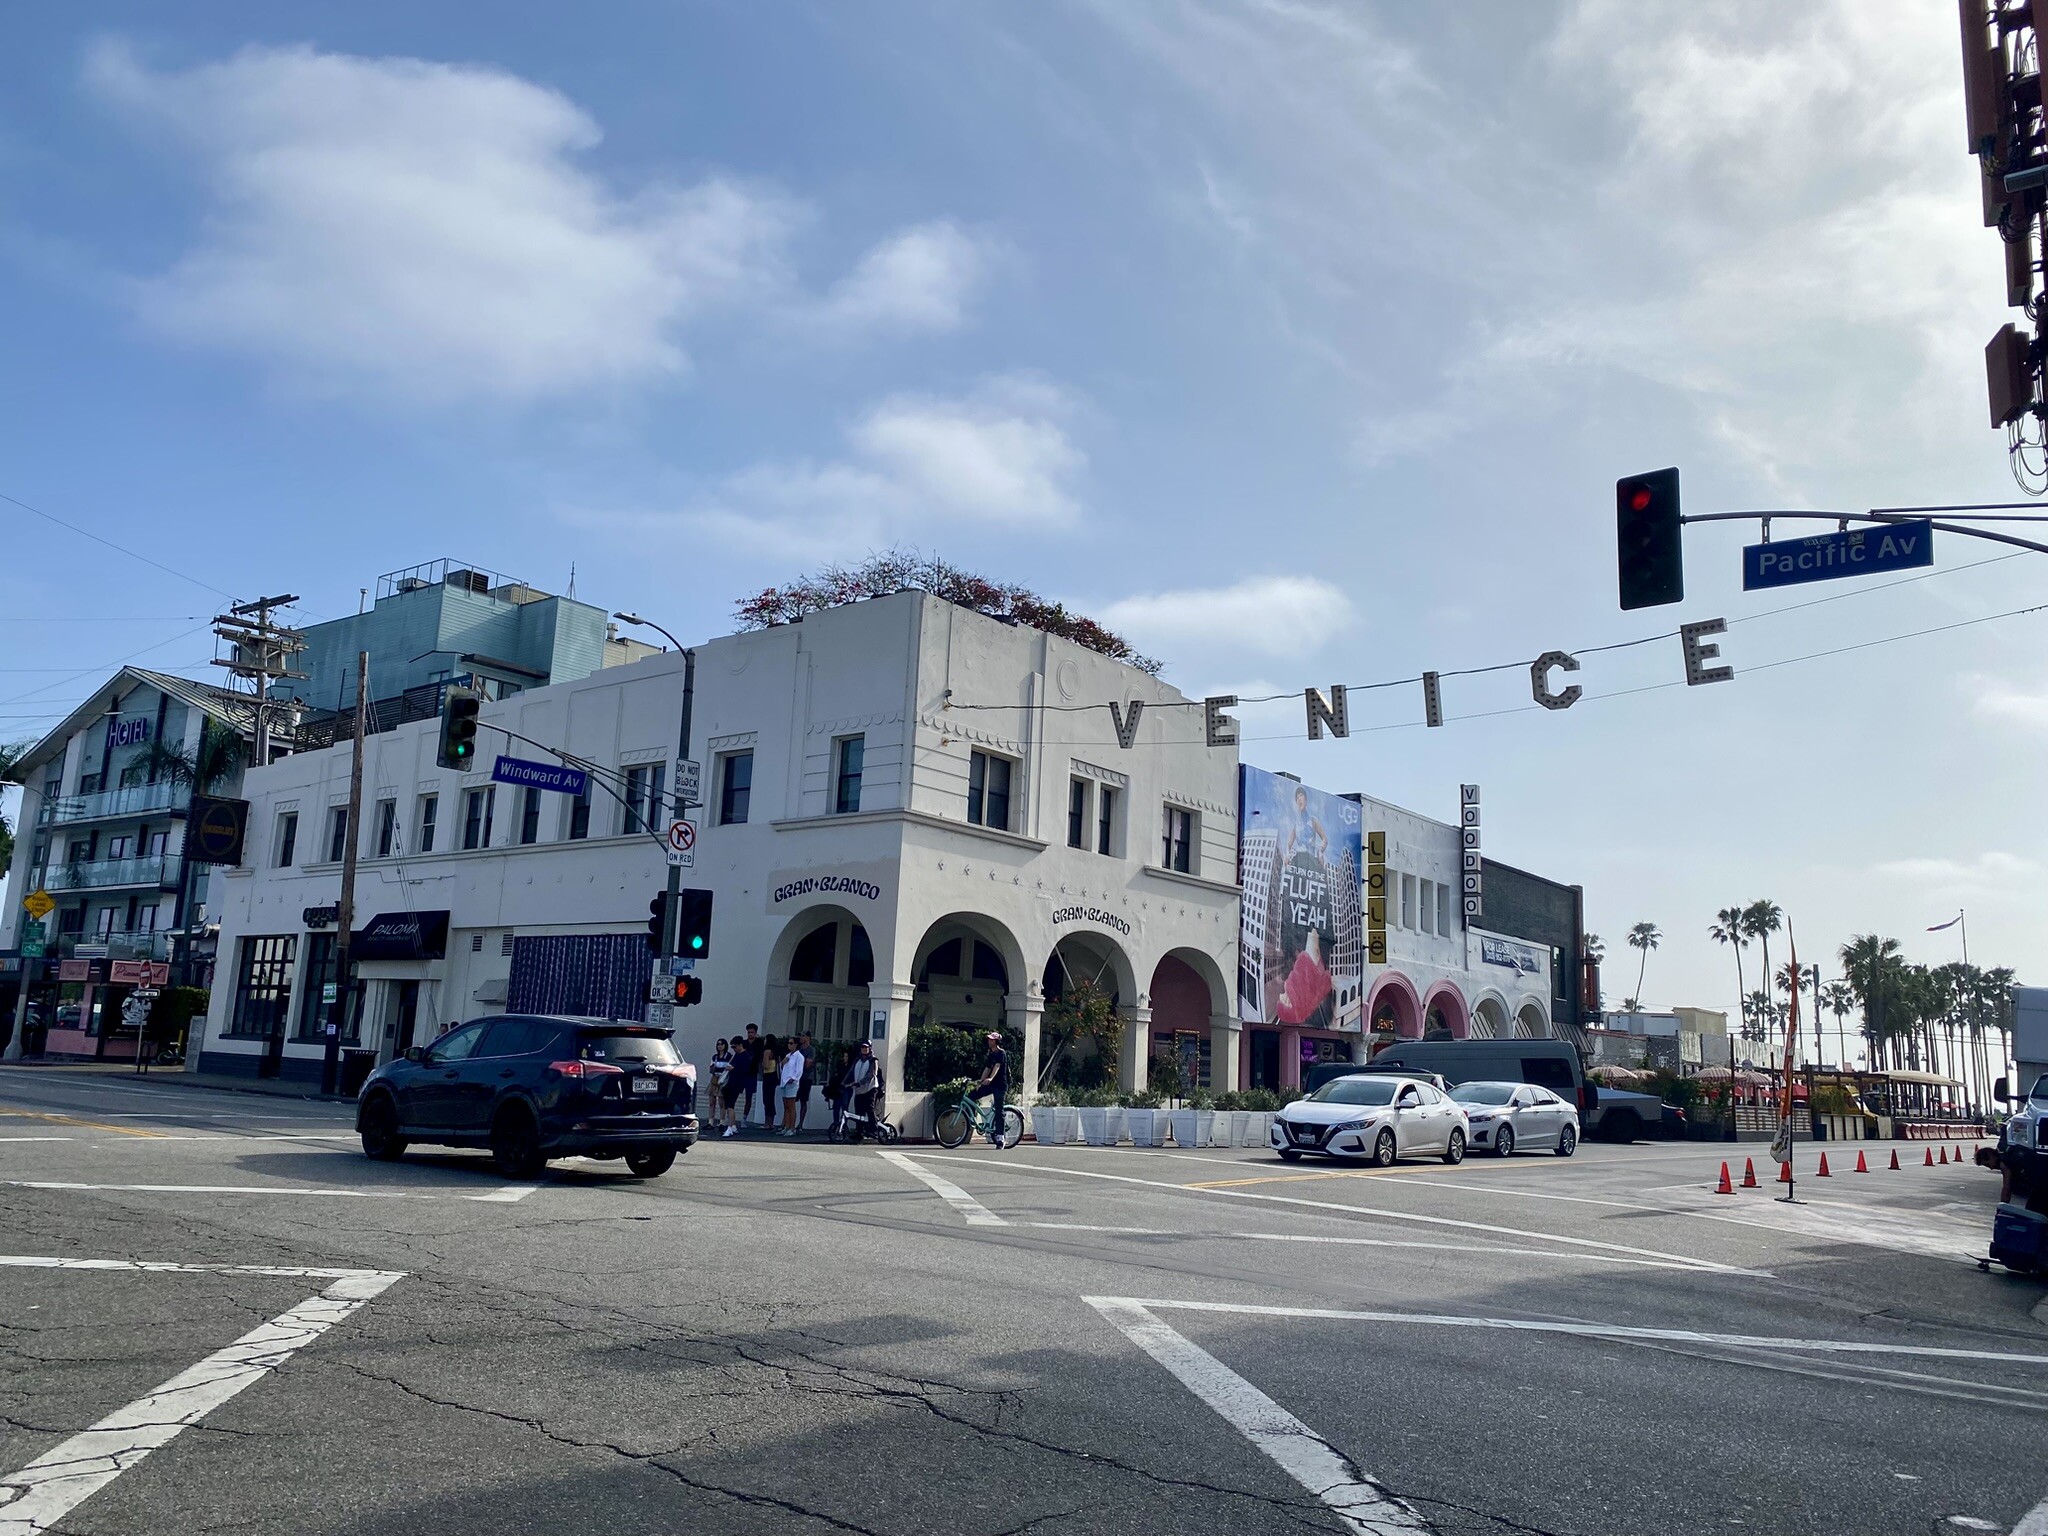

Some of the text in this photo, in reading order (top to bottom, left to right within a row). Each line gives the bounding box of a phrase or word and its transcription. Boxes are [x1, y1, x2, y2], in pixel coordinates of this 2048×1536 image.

[1758, 541, 1867, 576] Pacific
[1877, 534, 1918, 559] Av
[1110, 617, 1734, 749] VENICE
[107, 717, 146, 747] HOTEL
[500, 762, 580, 788] Windward Av
[676, 776, 698, 788] BLOCK
[677, 763, 698, 776] DO NOT
[1337, 803, 1358, 825] UGG
[669, 852, 692, 863] ON RED
[1465, 788, 1477, 912] VOODOO
[1281, 873, 1327, 904] FLUFF
[1290, 901, 1327, 930] YEAH
[372, 924, 420, 936] PALOMA
